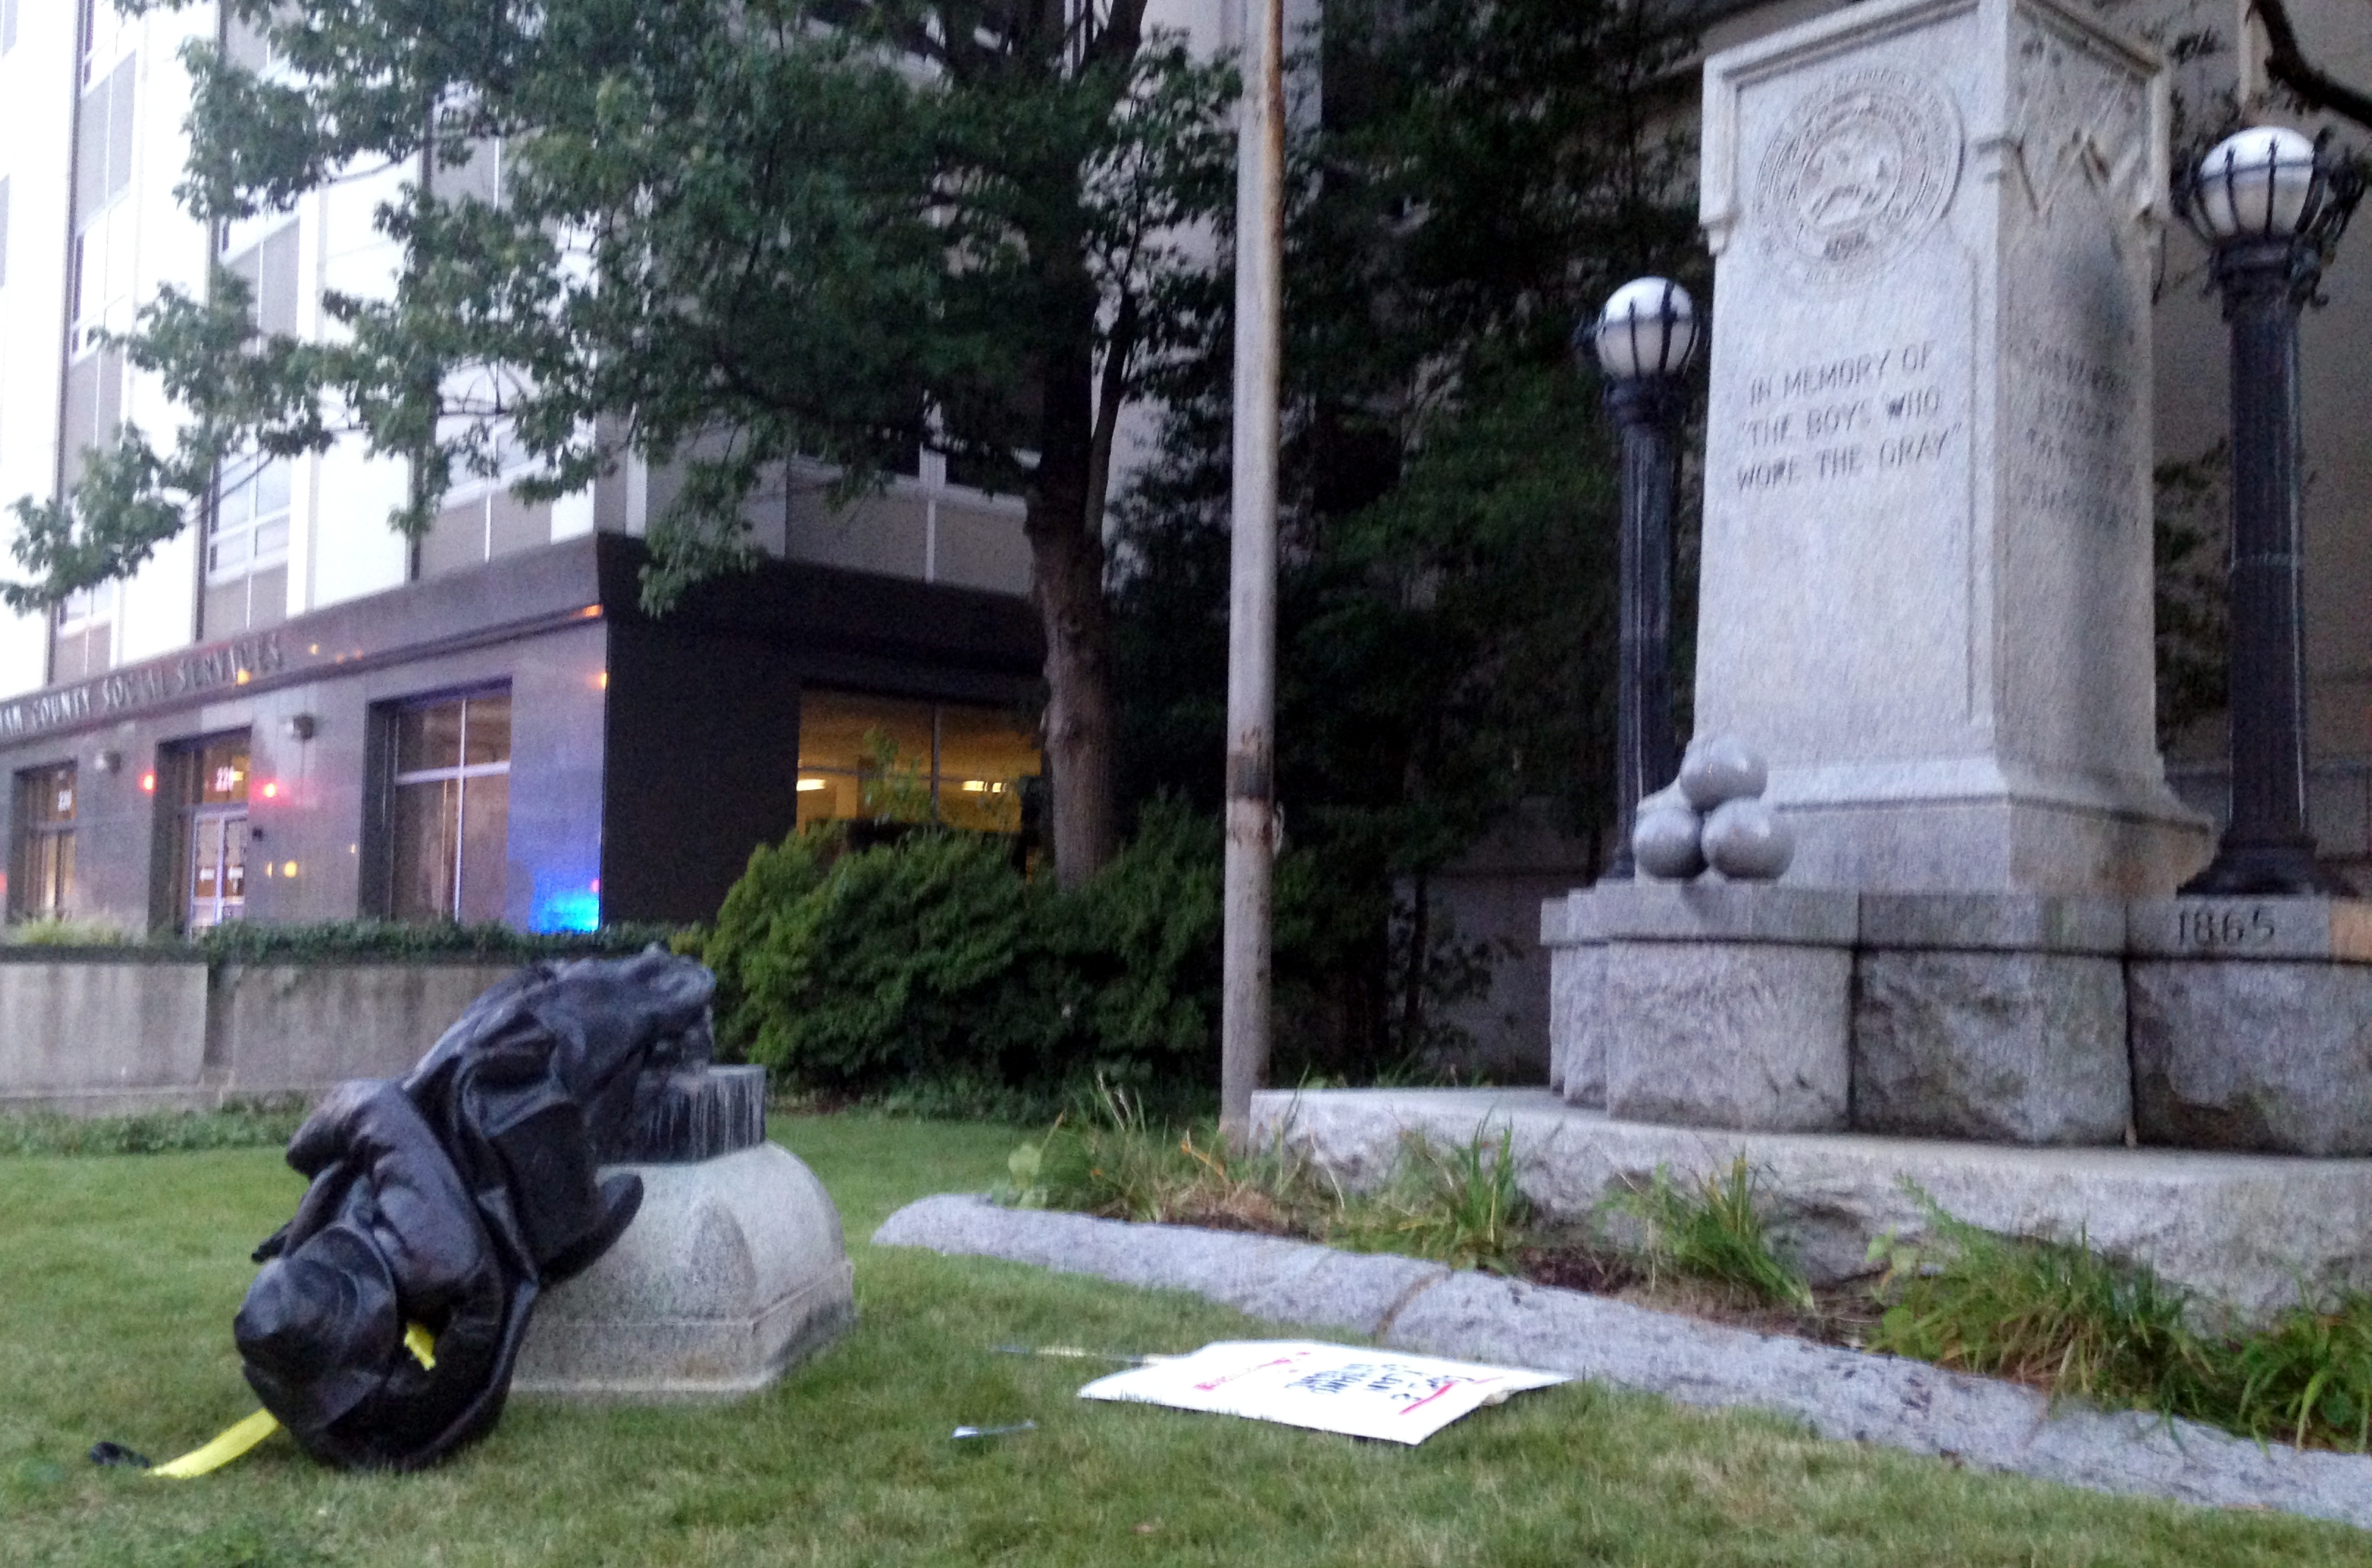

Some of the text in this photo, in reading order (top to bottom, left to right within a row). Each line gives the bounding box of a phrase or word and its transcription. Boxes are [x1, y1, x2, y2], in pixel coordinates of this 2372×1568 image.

[1747, 339, 1938, 408] IN MEMORY OF
[1805, 399, 1872, 442] BOYS
[1880, 384, 1942, 422] WHO
[1736, 454, 1800, 492] WORE
[1813, 443, 1865, 480] THE
[2177, 905, 2276, 949] 1865
